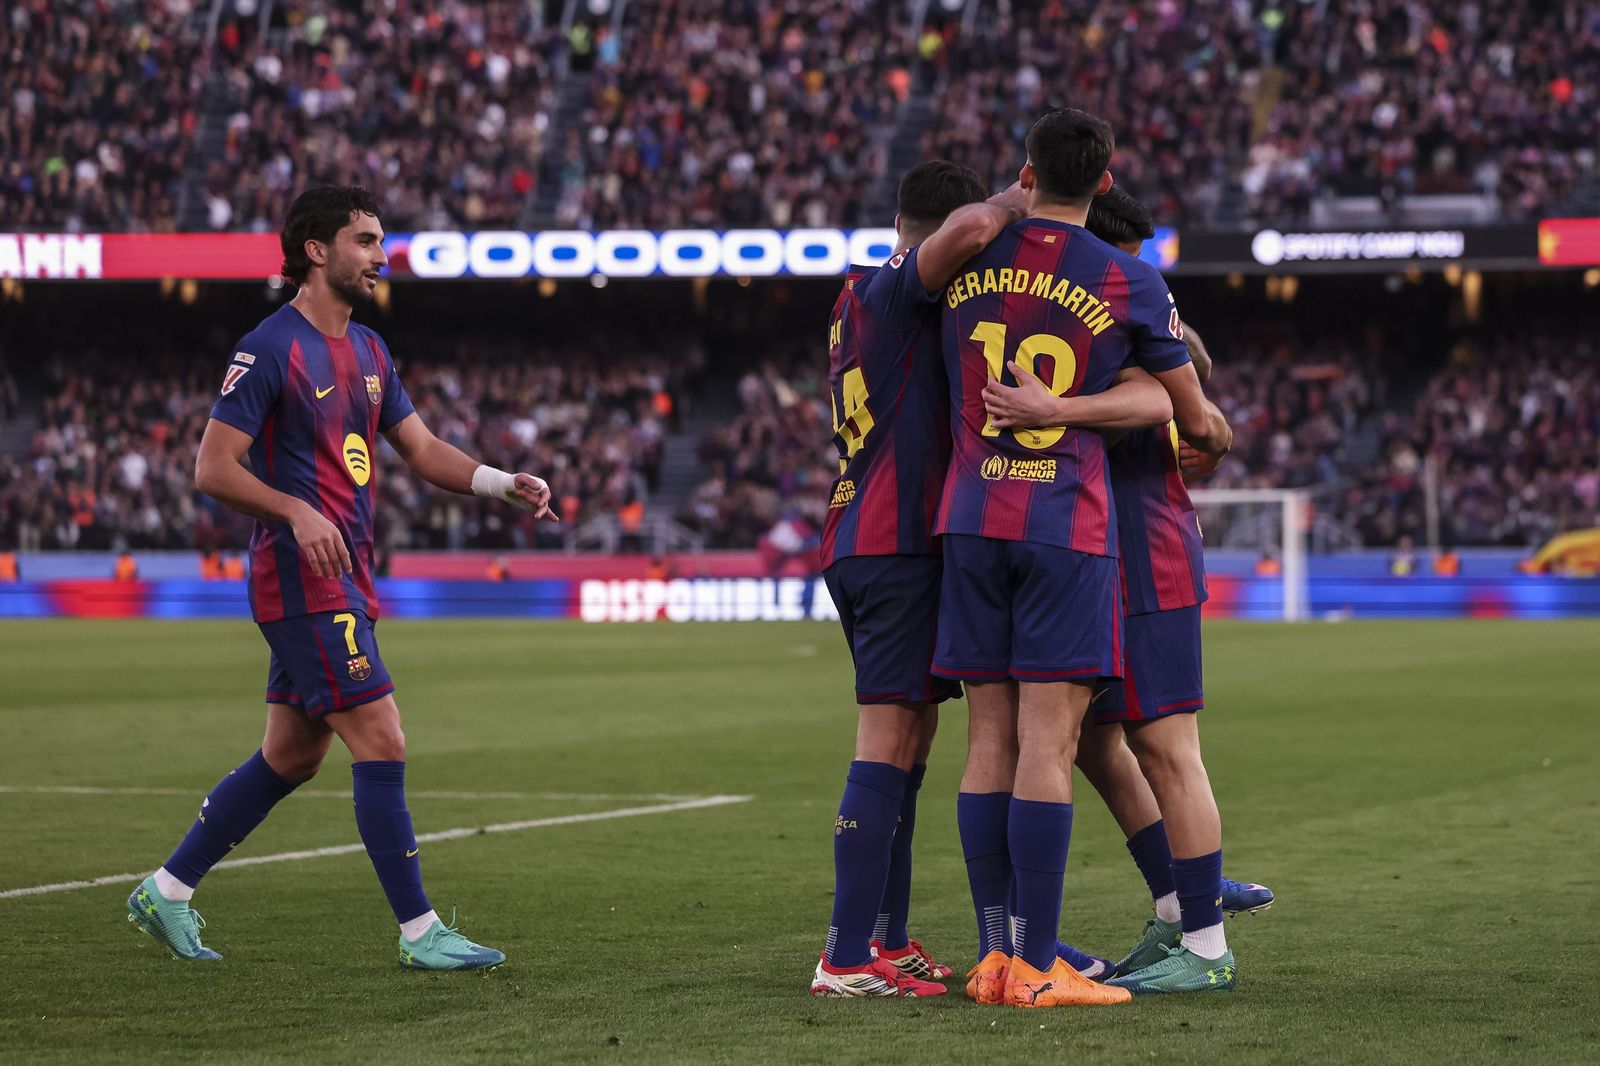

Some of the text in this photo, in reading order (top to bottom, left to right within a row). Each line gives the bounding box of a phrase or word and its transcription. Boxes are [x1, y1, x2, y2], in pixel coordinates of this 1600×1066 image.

[946, 268, 1115, 336] GERARD MARTÍN
[1008, 468, 1056, 479] ACNUR
[1011, 460, 1057, 470] UNHCR
[580, 578, 806, 622] DISPONIBLE
[333, 612, 359, 656] 7
